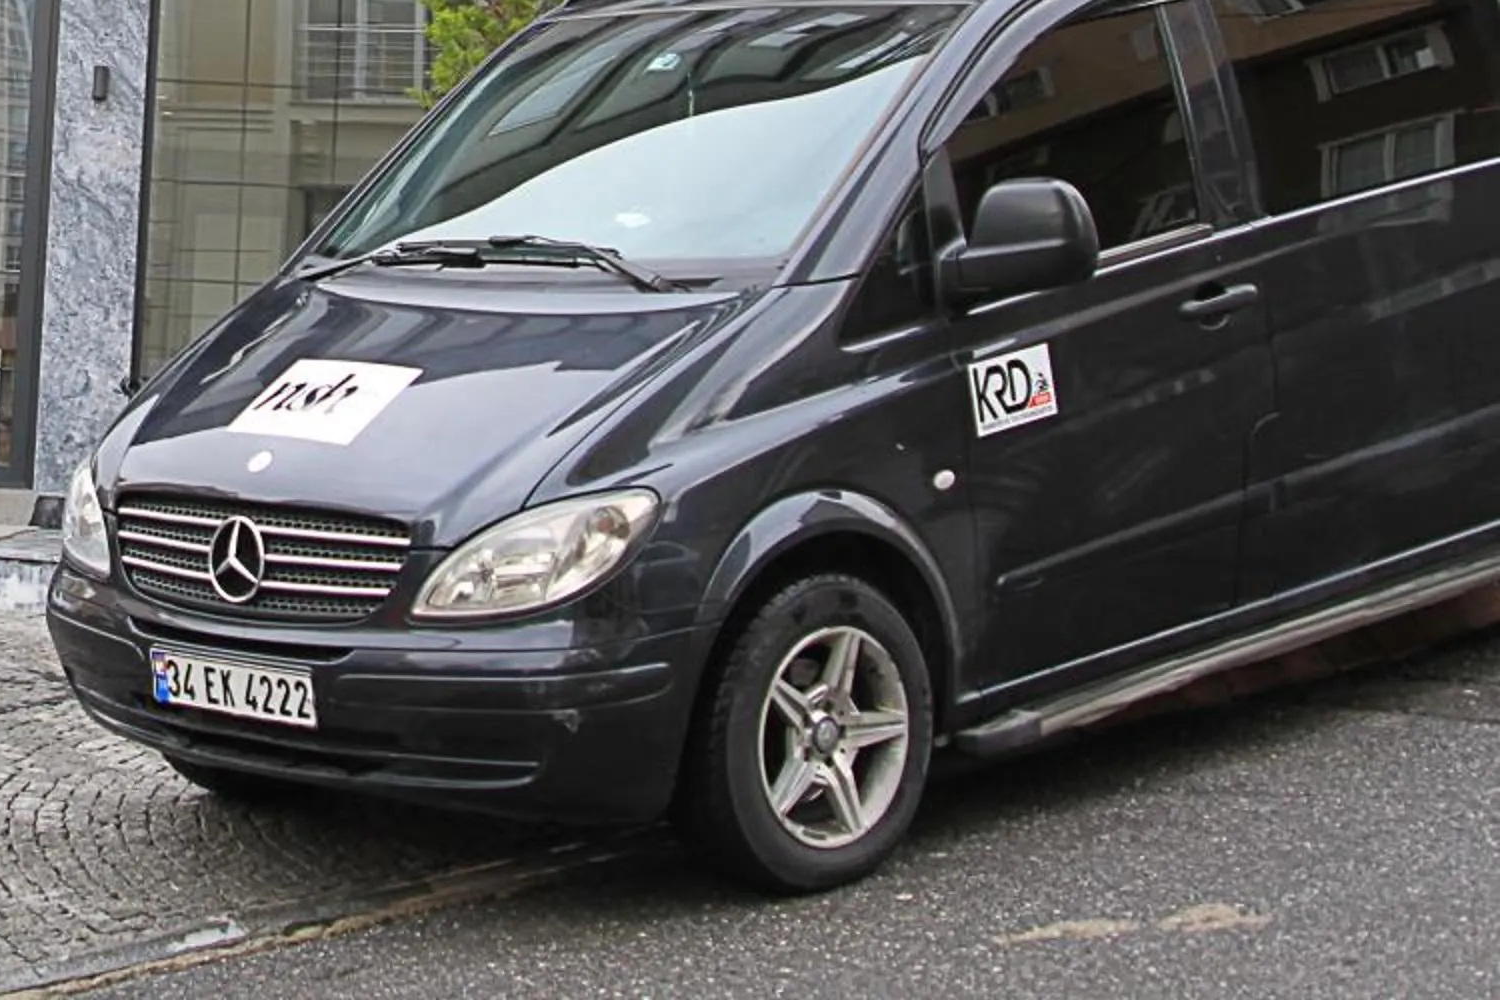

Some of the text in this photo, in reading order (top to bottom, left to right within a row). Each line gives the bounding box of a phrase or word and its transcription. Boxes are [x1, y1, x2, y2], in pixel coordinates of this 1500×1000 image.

[973, 359, 1031, 422] KRD
[167, 660, 310, 718] 34 EK 4222
